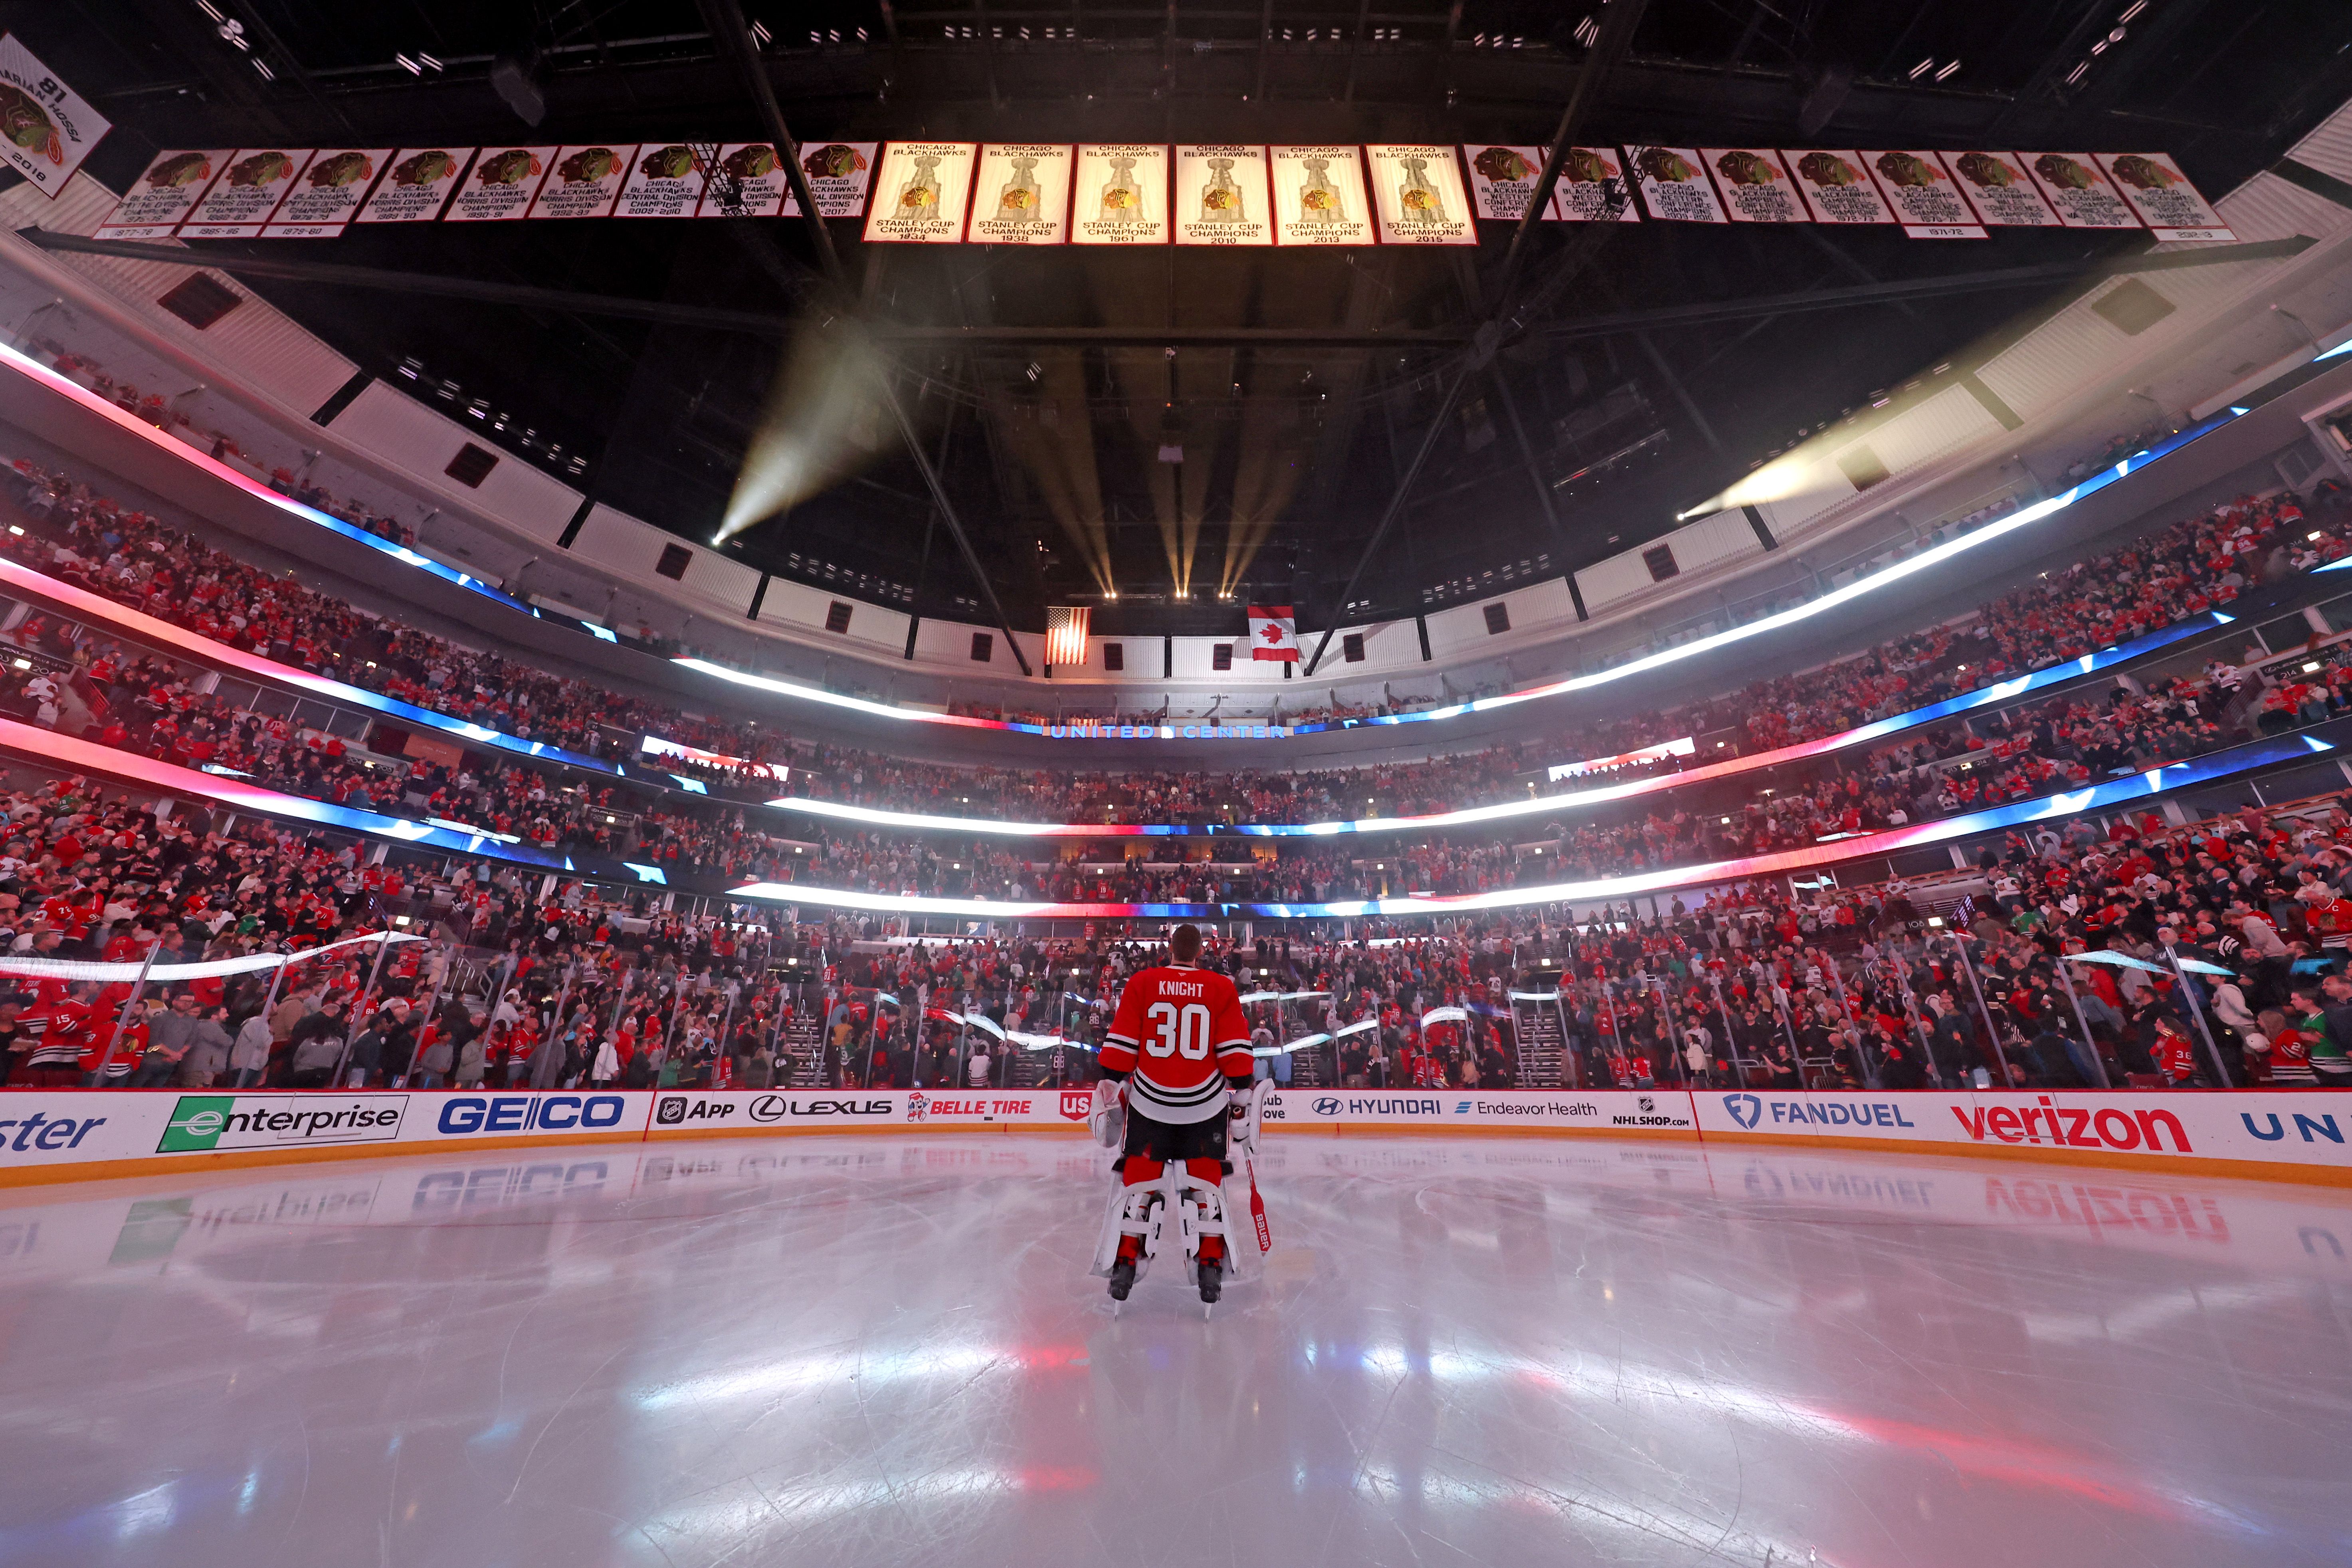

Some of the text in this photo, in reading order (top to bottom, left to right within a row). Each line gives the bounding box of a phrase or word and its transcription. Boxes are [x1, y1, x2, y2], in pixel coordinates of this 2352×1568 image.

[39, 77, 67, 103] 81
[48, 103, 81, 142] HOSSA
[12, 152, 46, 181] 2018
[2280, 670, 2297, 679] 214
[1050, 725, 1286, 739] UNITED CENTER
[824, 971, 831, 980] 81
[1159, 981, 1204, 998] KNIGHT
[56, 1014, 70, 1024] 15
[1146, 1002, 1210, 1061] 30
[2176, 1050, 2192, 1060] 36
[438, 1096, 624, 1134] GEICO
[666, 1105, 681, 1115] NHL
[790, 1101, 892, 1115] LEXUS
[930, 1101, 1032, 1115] BELLE TIRE
[1350, 1099, 1441, 1115] HYUNDAI
[1477, 1101, 1598, 1116] Endeavor Health
[1770, 1102, 1914, 1128] FANDUEL
[169, 1104, 398, 1136] enterprise
[1950, 1096, 2193, 1152] verizon
